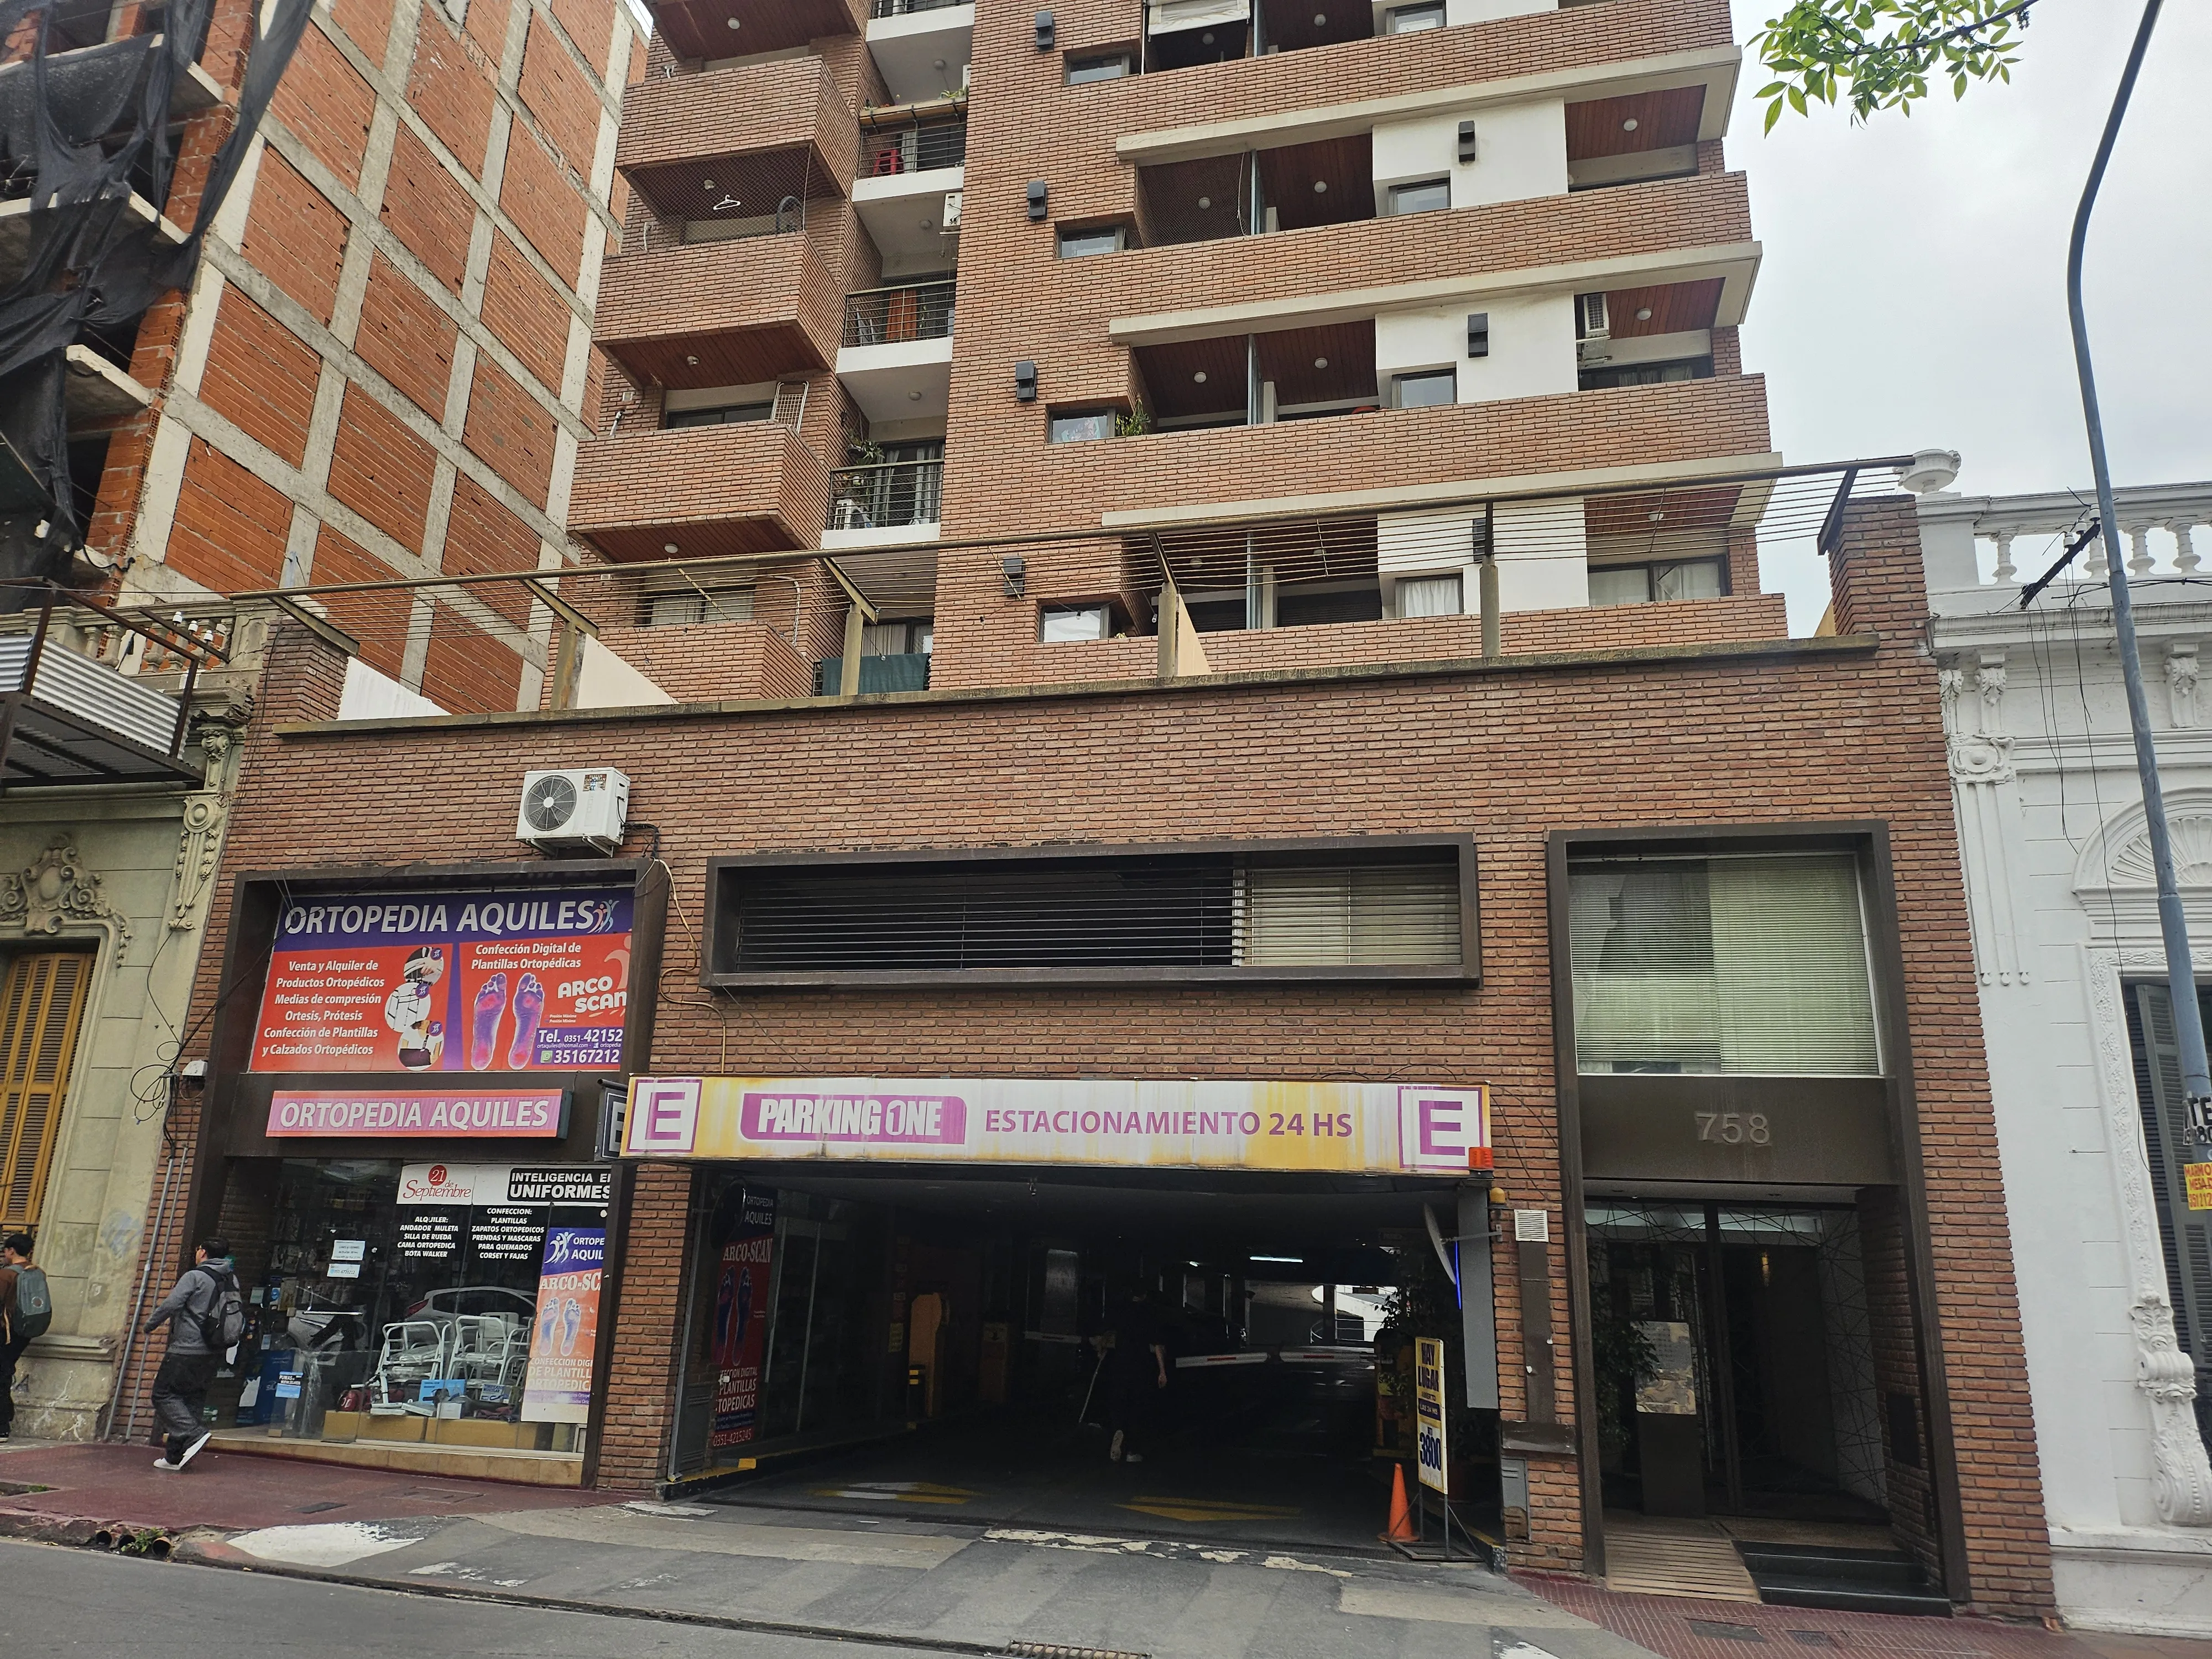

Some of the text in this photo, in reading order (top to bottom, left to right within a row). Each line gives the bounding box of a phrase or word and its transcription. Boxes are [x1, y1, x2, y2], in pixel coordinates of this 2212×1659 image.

[285, 900, 594, 935] ORTOPEDIA AQUILES
[476, 942, 581, 956] Confección Digital de
[289, 960, 378, 973] Venta y Alquiler de
[471, 958, 581, 971] Plantillas Ortopédicas
[276, 977, 384, 989] Productos Ortopédicos
[558, 976, 613, 998] ARCO
[275, 993, 381, 1006] Medias de compresión
[285, 1010, 363, 1022] Ortesis, Prótesis
[264, 1027, 378, 1037] Confección de Plantillas
[539, 1029, 561, 1042] Tel.
[262, 1044, 374, 1057] y Calzados Ortopédicos
[554, 1050, 620, 1063] 35167212
[280, 1100, 550, 1131] ORTOPEDIA AQUILES
[645, 1092, 686, 1140] E
[757, 1099, 882, 1136] PARKING
[985, 1109, 1353, 1138] ESTACIONAMIENTO 24 HS
[1418, 1099, 1466, 1156] E
[1697, 1113, 1770, 1144] 758
[430, 1169, 445, 1182] 21
[511, 1172, 593, 1182] INTELIGENCIA
[403, 1180, 471, 1201] Septiembre
[510, 1184, 610, 1199] UNIFORMES
[747, 1196, 774, 1207] ORTOPEDIA
[744, 1211, 772, 1225] AQUILES
[573, 1237, 605, 1245] ORTOPE
[571, 1249, 603, 1261] AQUIL
[723, 1238, 773, 1263] ARCO-SCAN
[539, 1272, 601, 1291] ARCO-SC
[530, 1358, 576, 1366] CONFECCION
[528, 1366, 592, 1379] DE PLANTILL
[528, 1379, 591, 1391] ORTOPEDIC
[719, 1378, 757, 1395] PLANTILLAS
[1420, 1432, 1441, 1471] 3800
